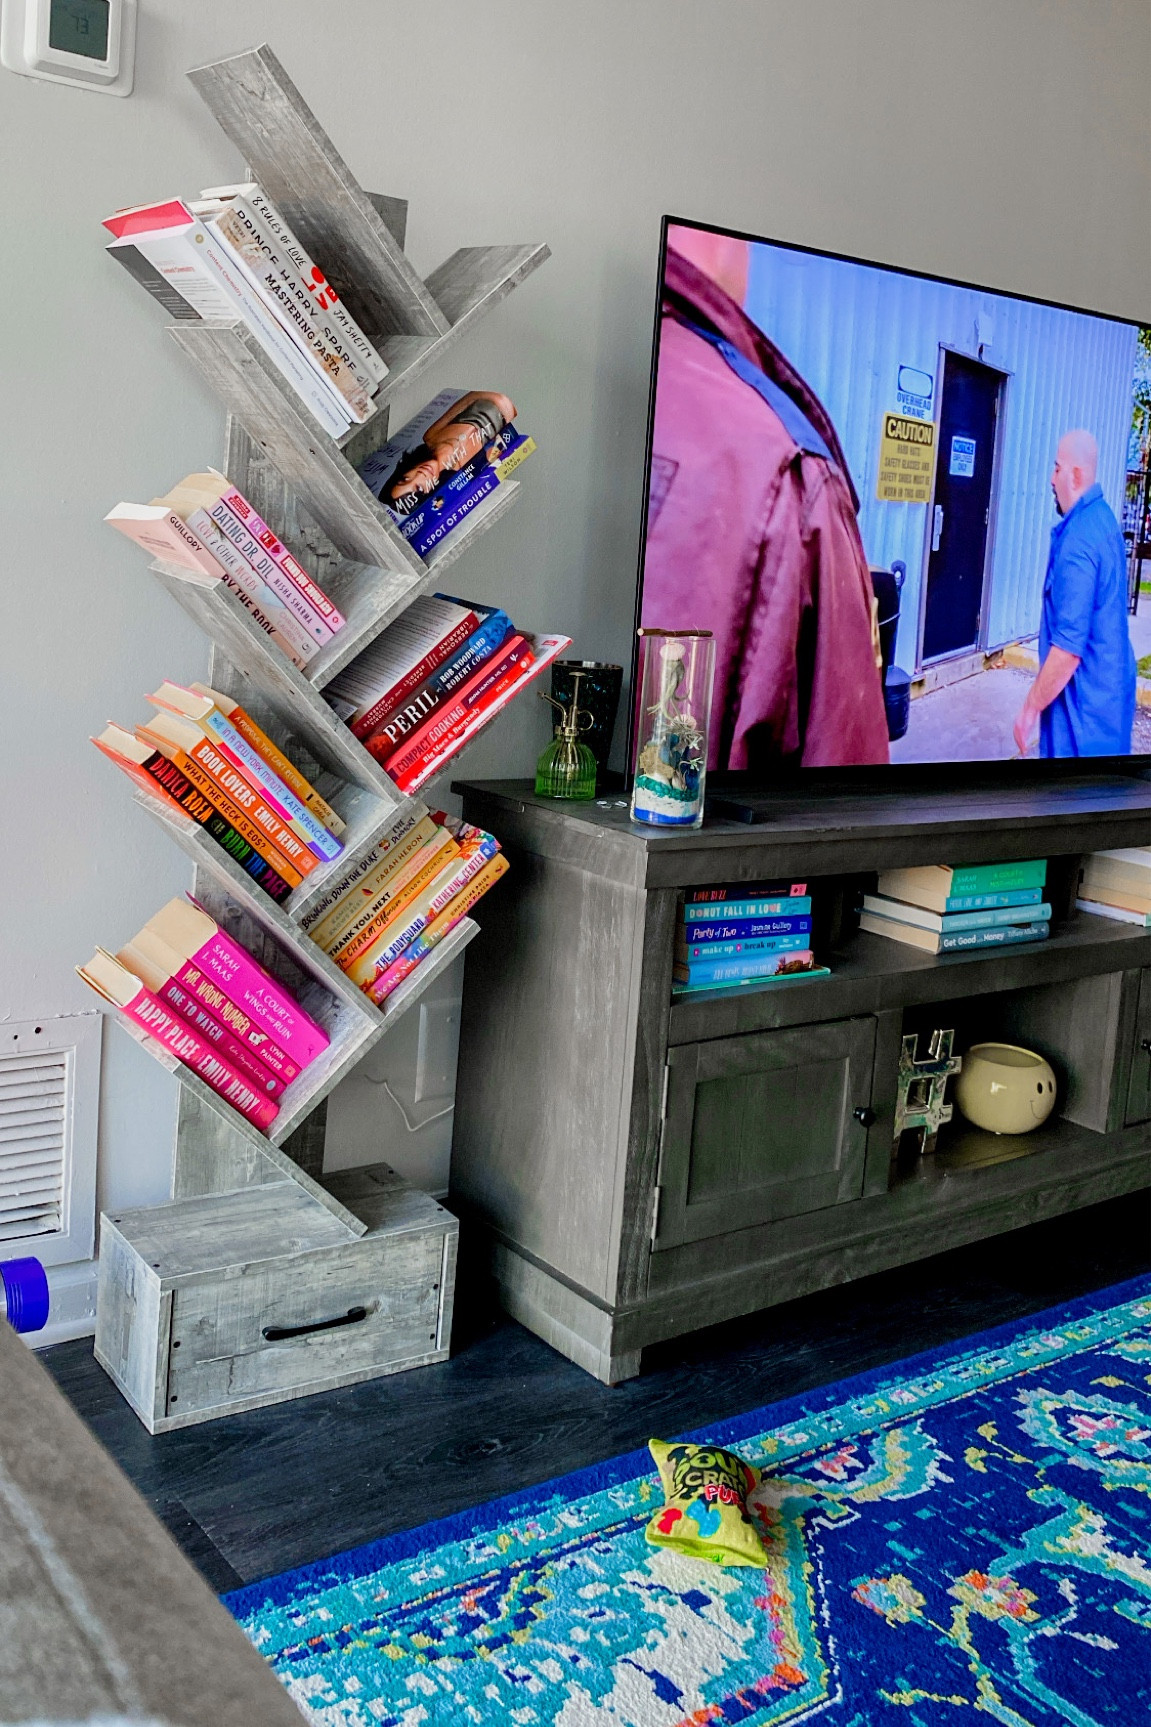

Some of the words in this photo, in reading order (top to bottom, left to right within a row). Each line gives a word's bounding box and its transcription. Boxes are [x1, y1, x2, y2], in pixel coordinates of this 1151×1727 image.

[252, 196, 261, 207] 8
[260, 206, 283, 234] RULES
[280, 234, 292, 245] OF
[287, 246, 306, 267] LOVE
[206, 249, 224, 272] Content
[222, 270, 243, 297] Chemistry
[237, 210, 279, 266] PRINCE
[280, 269, 319, 316] HARRY
[323, 327, 357, 371] SPARE
[264, 273, 316, 340] MASTERING
[313, 339, 340, 376] PASTA
[333, 309, 349, 327] JAY
[345, 325, 372, 359] SHETTY
[897, 392, 931, 411] OVERHEAD
[903, 405, 925, 419] CRANE
[888, 419, 932, 444] CAUTION
[395, 492, 418, 514] MISS
[425, 476, 439, 493] ME
[442, 447, 467, 470] WITH
[469, 422, 492, 446] THAT
[448, 464, 476, 490] CONSTANCE
[456, 474, 474, 491] GILLAM
[504, 458, 520, 474] WILSON
[169, 516, 202, 552] GUILLORY
[420, 544, 427, 552] A
[427, 525, 446, 546] SPOT
[447, 513, 458, 526] OF
[457, 481, 492, 516] TROUBLE
[196, 520, 212, 539] LOVE
[216, 544, 235, 567] OTHER
[234, 565, 257, 591] WORDS
[212, 505, 246, 545] DATING
[242, 541, 258, 562] DR.
[256, 559, 273, 579] DIL
[273, 578, 292, 600] NISHA
[291, 597, 313, 625] SHARMA
[438, 629, 470, 658] PERSONAL
[439, 621, 470, 651] LIBRARIAN
[439, 668, 454, 684] BOB
[452, 637, 486, 672] WOODWARD
[445, 663, 472, 691] ROBERT
[470, 646, 493, 667] COSTA
[382, 689, 439, 744] PERIL
[396, 737, 431, 773] COMPACT
[429, 705, 465, 741] COOKING
[422, 749, 436, 763] Big
[434, 735, 450, 753] Macs
[447, 728, 455, 739] &
[453, 706, 481, 735] Burgundy
[197, 745, 220, 771] BOOK
[220, 769, 257, 808] LOVERS
[221, 727, 231, 736] IN
[233, 739, 253, 757] NEW
[247, 755, 264, 774] YORK
[260, 769, 284, 795] MINUTE
[149, 755, 189, 799] DANICA
[182, 792, 214, 825] ROEM
[183, 761, 207, 785] WHAT
[205, 785, 221, 801] THE
[219, 799, 241, 822] HECK
[238, 819, 249, 831] IS
[246, 828, 267, 850] EOS?
[253, 805, 281, 835] EMILY
[276, 829, 304, 858] HENRY
[283, 794, 301, 814] KATE
[298, 811, 329, 845] SPENCER
[390, 817, 416, 845] DUNMORE
[392, 819, 405, 834] EVIE
[220, 829, 250, 861] BURN
[244, 851, 266, 878] THE
[260, 869, 289, 896] PAGE
[376, 857, 400, 883] FARAH
[397, 834, 424, 861] HERON
[403, 879, 422, 897] ALISON
[420, 857, 444, 881] COCHRUN
[432, 877, 465, 909] KATHERINE
[462, 854, 485, 884] CENTER
[302, 896, 333, 931] BRINGING
[331, 881, 351, 901] DOWN
[348, 870, 363, 885] THE
[359, 850, 378, 872] DUKE
[689, 907, 720, 919] DONUT
[724, 905, 743, 916] FALL
[746, 905, 756, 915] IN
[758, 903, 782, 914] LOVE
[328, 932, 354, 957] THANK
[354, 913, 374, 935] YOU,
[372, 892, 391, 912] NEXT
[346, 925, 376, 958] CHARM
[375, 900, 402, 929] Offensive
[375, 951, 392, 971] THE
[388, 918, 425, 959] BODYGUARD
[693, 928, 714, 940] Party
[715, 929, 721, 938] of
[722, 927, 737, 937] Two
[702, 946, 722, 955] make
[724, 945, 734, 954] up
[744, 942, 766, 950] break
[766, 941, 776, 949] up
[750, 924, 771, 932] Jasmine
[944, 939, 956, 947] Get
[958, 935, 977, 945] Good
[983, 932, 1004, 942] Money
[201, 952, 208, 960] J.
[208, 958, 233, 982] MAAS
[213, 944, 240, 973] SARAH
[384, 970, 402, 988] Are
[397, 956, 415, 973] Not
[410, 942, 429, 960] Like
[426, 920, 449, 943] Them
[167, 986, 185, 1006] ONE
[186, 1002, 197, 1017] TO
[196, 1013, 223, 1042] WATCH
[182, 968, 201, 986] MR.
[196, 982, 223, 1009] WRONG
[221, 1001, 251, 1036] NUMBER
[243, 991, 268, 1017] WINGS
[273, 1021, 293, 1040] RUIN
[256, 988, 264, 996] A
[262, 995, 289, 1019] COURT
[134, 997, 172, 1033] HAPPY
[166, 1024, 200, 1060] PLACE
[269, 1045, 286, 1061] LYNN
[199, 1053, 232, 1087] EMILY
[227, 1078, 261, 1113] HENRY
[260, 1048, 283, 1071] PAINTER
